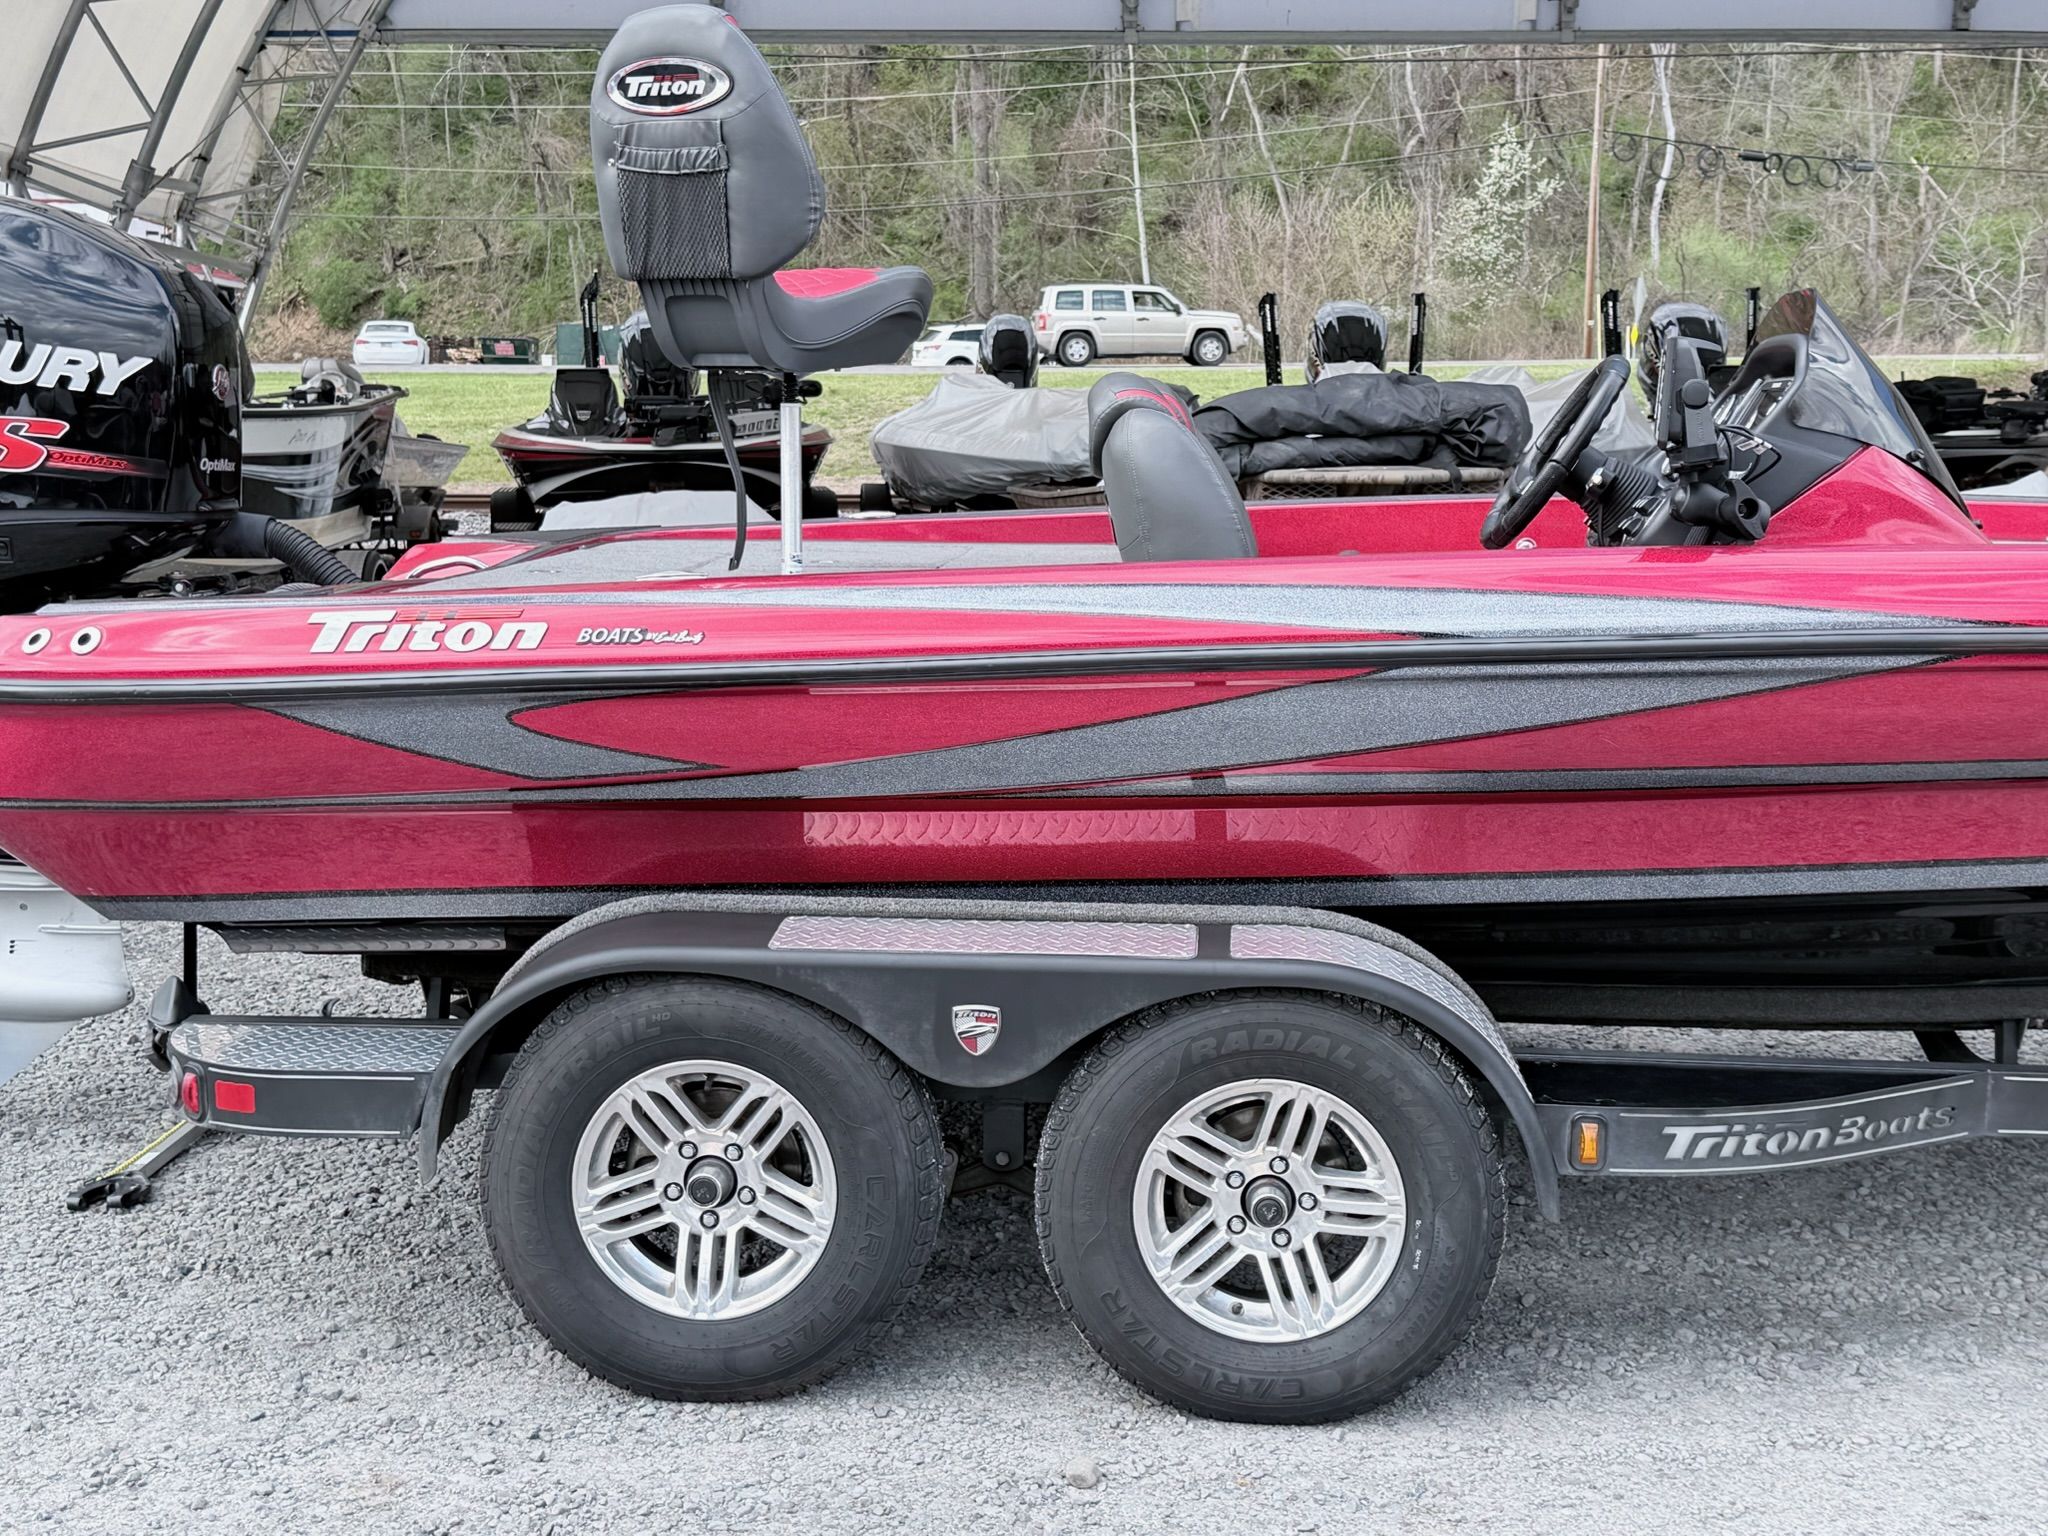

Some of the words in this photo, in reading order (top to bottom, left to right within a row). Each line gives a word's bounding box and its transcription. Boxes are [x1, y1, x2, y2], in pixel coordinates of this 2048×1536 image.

[625, 75, 705, 98] Triton
[0, 340, 154, 396] URY
[49, 452, 129, 470] OptiMax
[200, 457, 236, 474] OptiMax
[307, 609, 549, 653] Triton
[576, 627, 643, 644] BOATS
[549, 1015, 662, 1097] TRAIL
[651, 1011, 672, 1023] HD
[1189, 1028, 1358, 1070] RADIAL
[1662, 1124, 1833, 1160] Triton
[1834, 1106, 1956, 1146] Boats
[768, 1174, 890, 1363] CARLSTAR
[1100, 1286, 1306, 1401] CARLSTAR
